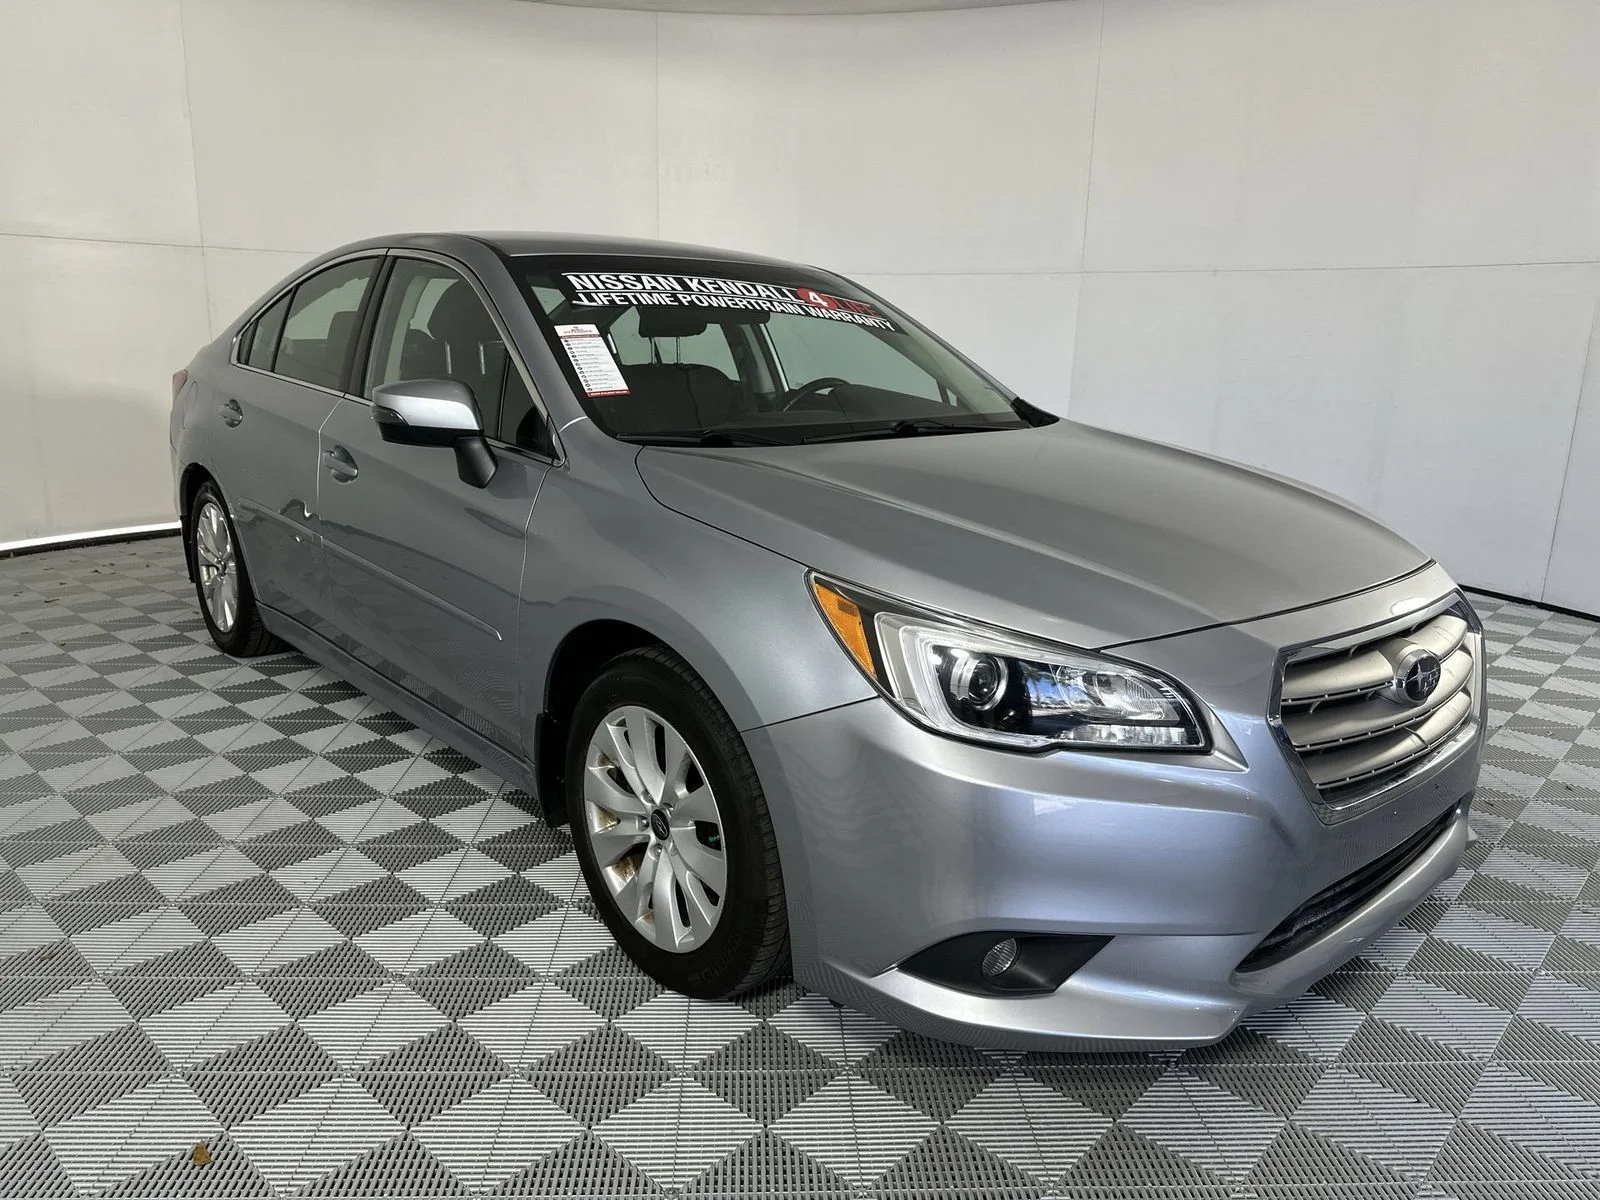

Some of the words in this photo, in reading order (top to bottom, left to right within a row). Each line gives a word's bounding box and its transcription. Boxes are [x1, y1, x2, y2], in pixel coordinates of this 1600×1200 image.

[566, 274, 684, 291] NISSAN
[682, 277, 805, 303] KENDALL
[807, 291, 829, 308] 4
[832, 297, 881, 316] LIFE
[577, 292, 680, 306] LIFETIME
[676, 294, 807, 316] POWERTRAIN
[802, 305, 896, 332] WARRANTY
